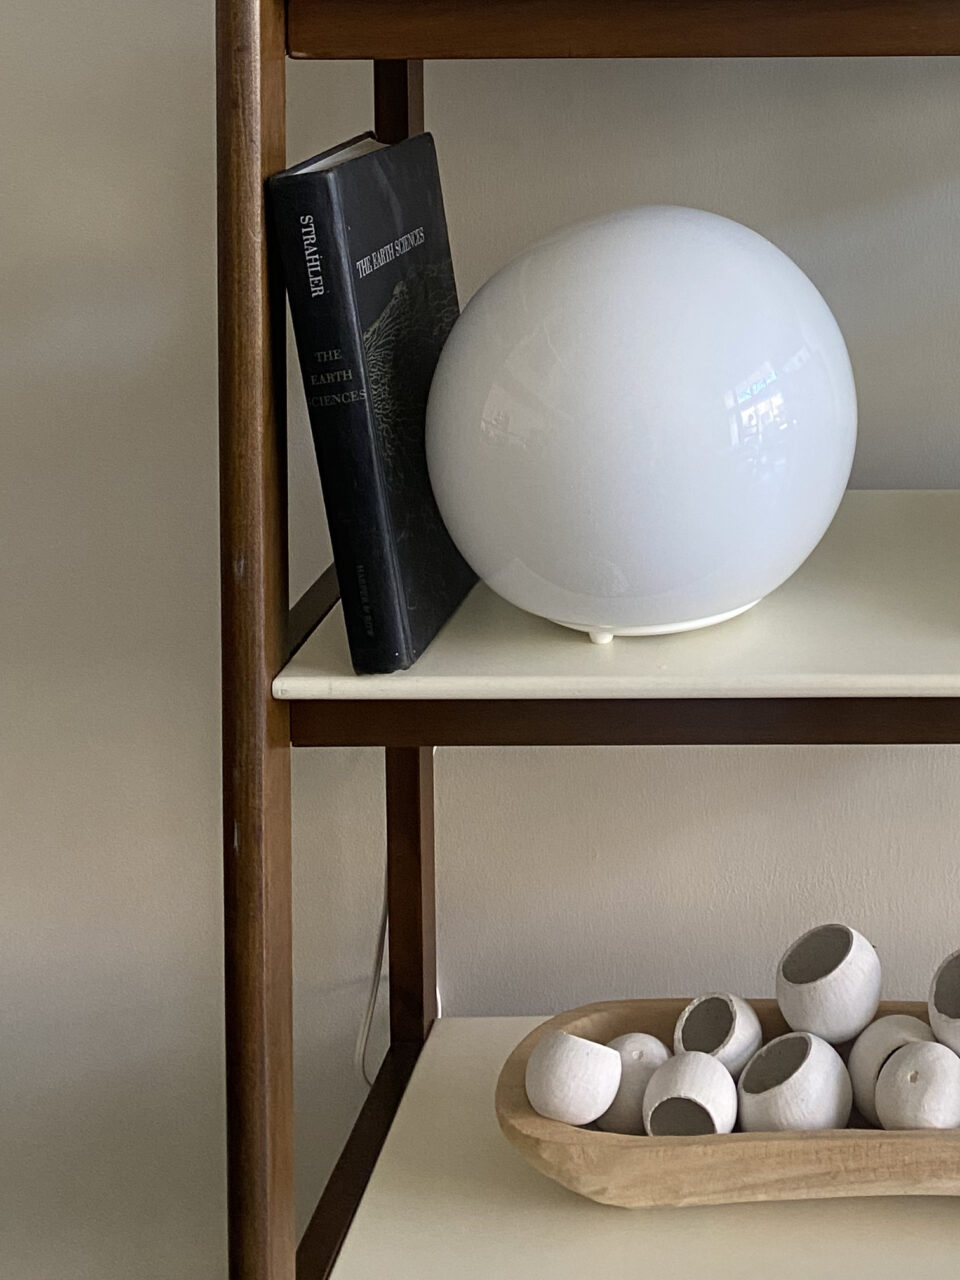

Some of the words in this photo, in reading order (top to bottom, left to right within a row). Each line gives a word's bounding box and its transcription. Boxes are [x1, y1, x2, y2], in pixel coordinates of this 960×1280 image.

[300, 214, 325, 298] STRAHLER
[356, 255, 373, 279] THE
[371, 242, 395, 270] EARTH
[394, 226, 425, 257] SCIENCES
[314, 349, 343, 362] THE
[310, 369, 353, 385] EARTH
